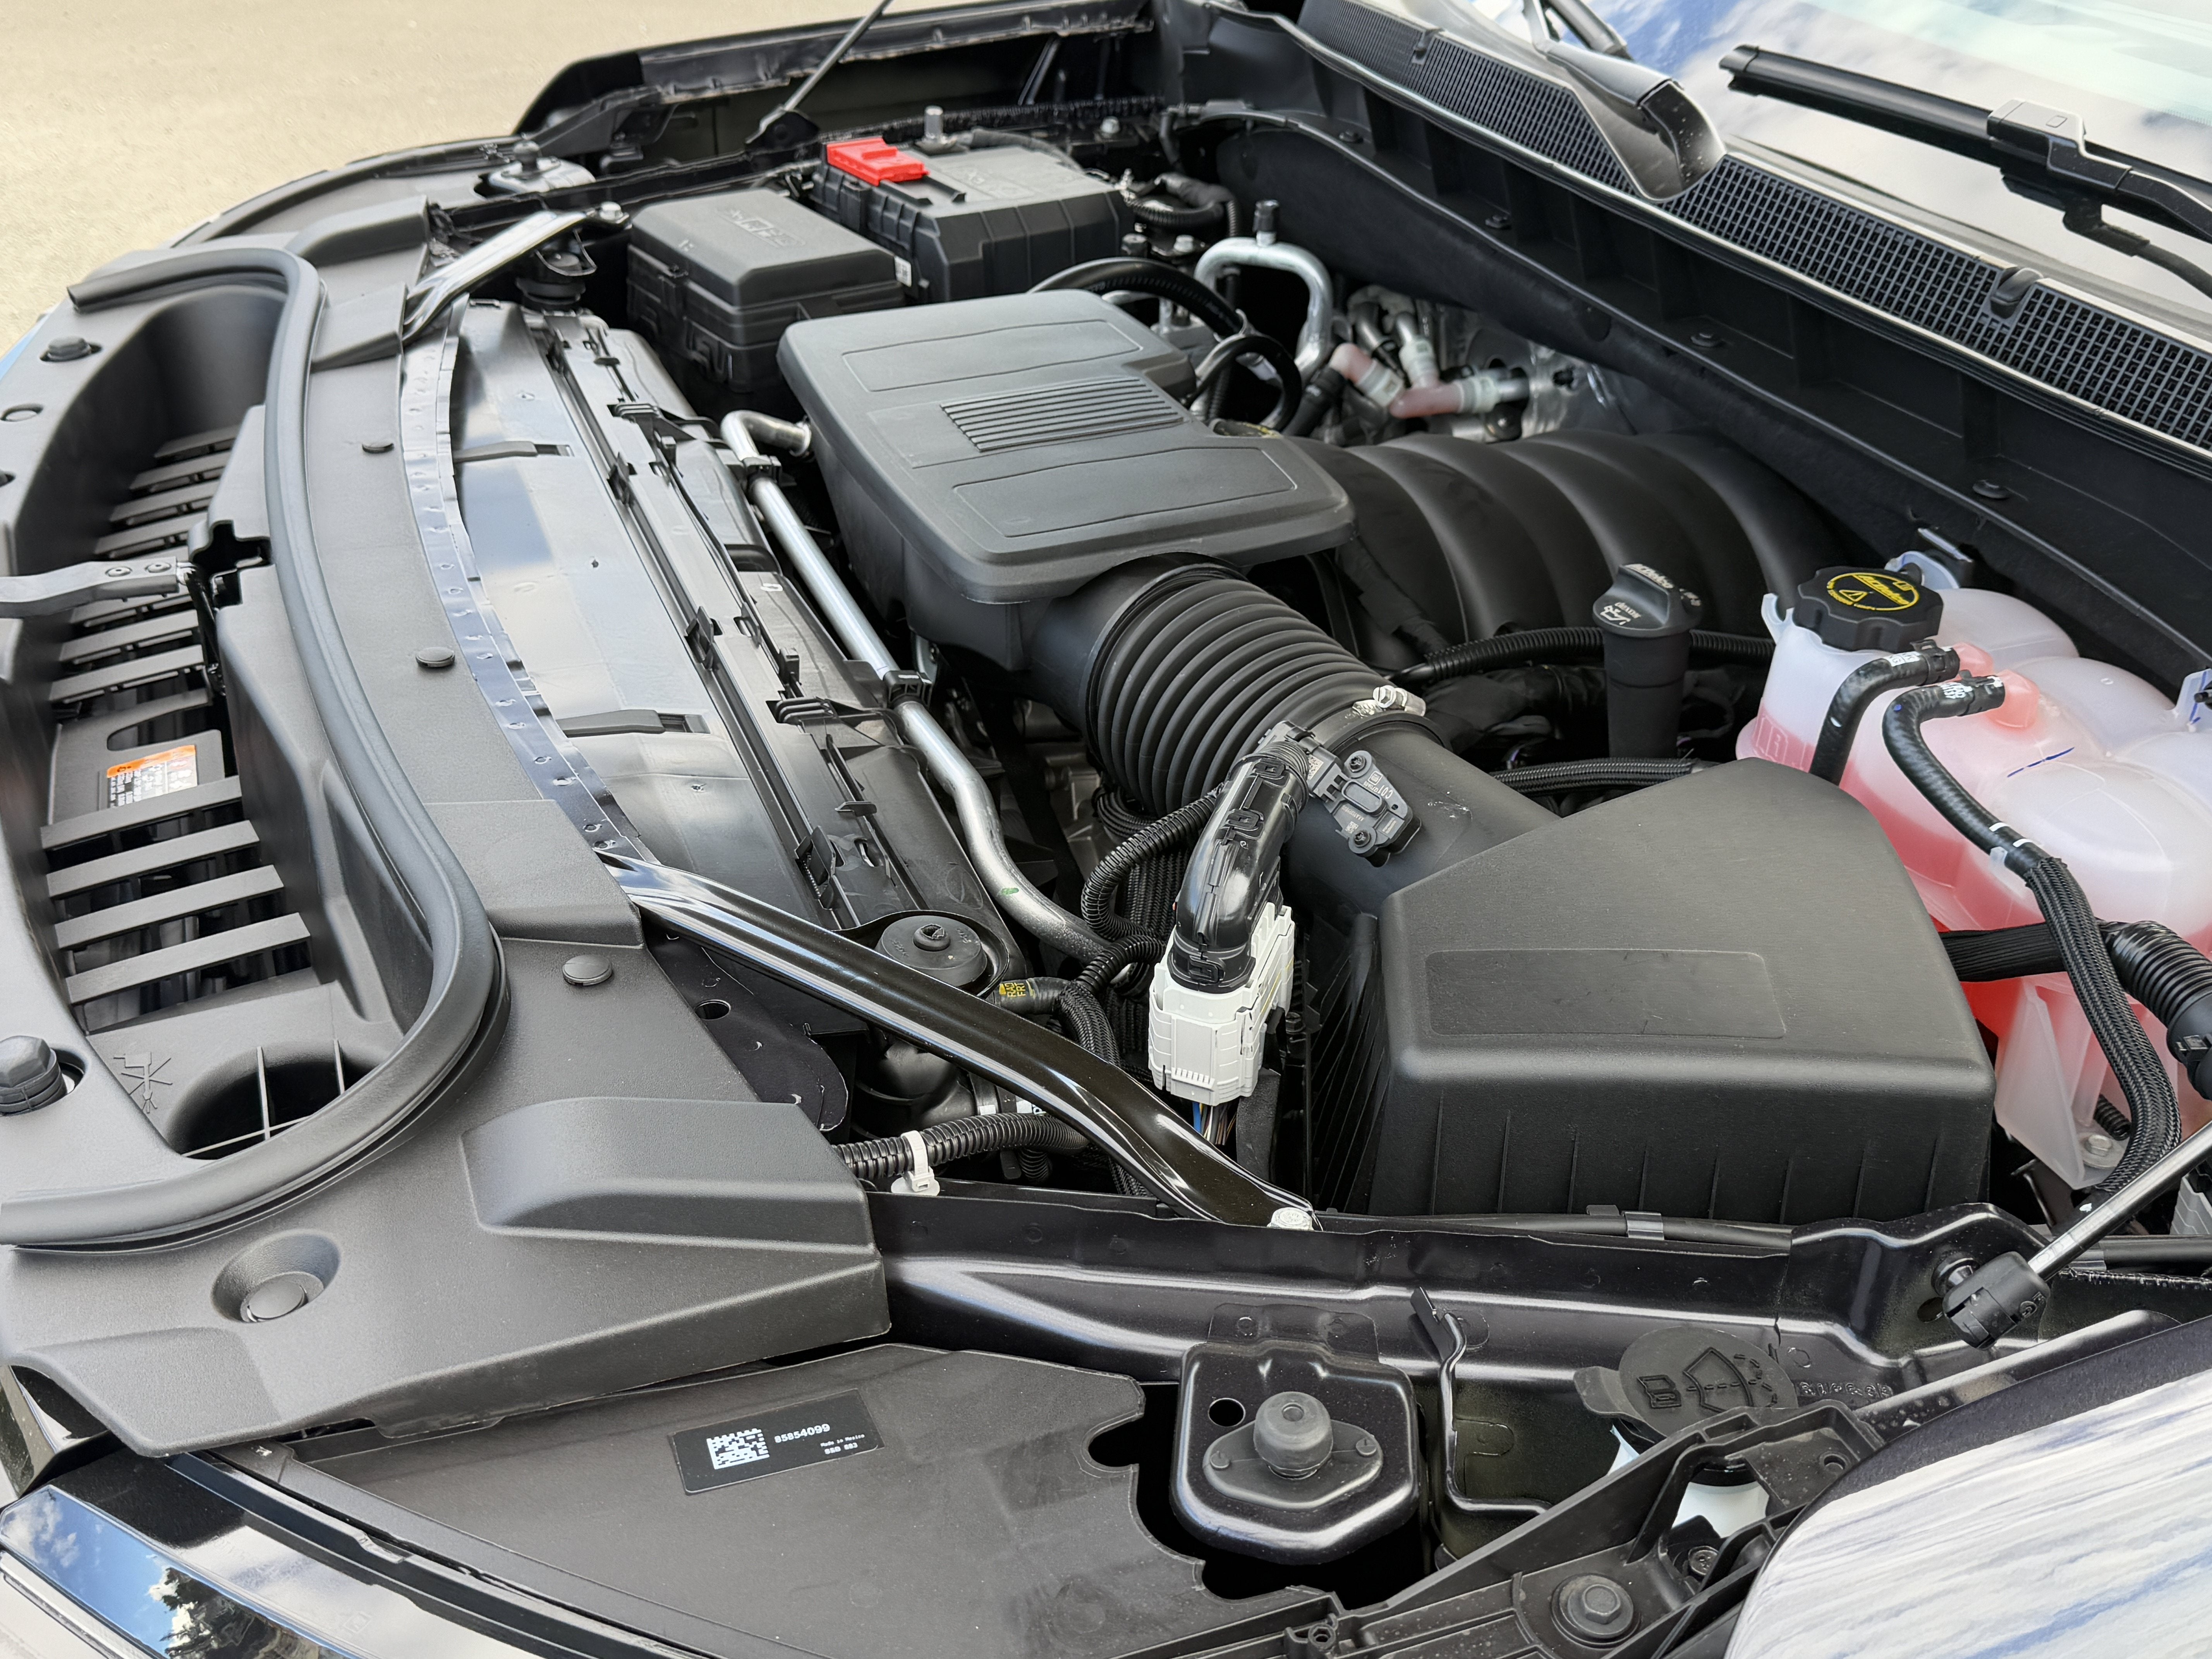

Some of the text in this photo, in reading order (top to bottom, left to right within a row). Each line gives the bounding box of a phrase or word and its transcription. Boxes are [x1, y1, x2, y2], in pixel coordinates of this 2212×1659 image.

[1004, 982, 1017, 997] RAD
[1014, 982, 1027, 997] FRT
[774, 1424, 830, 1443] 85854099
